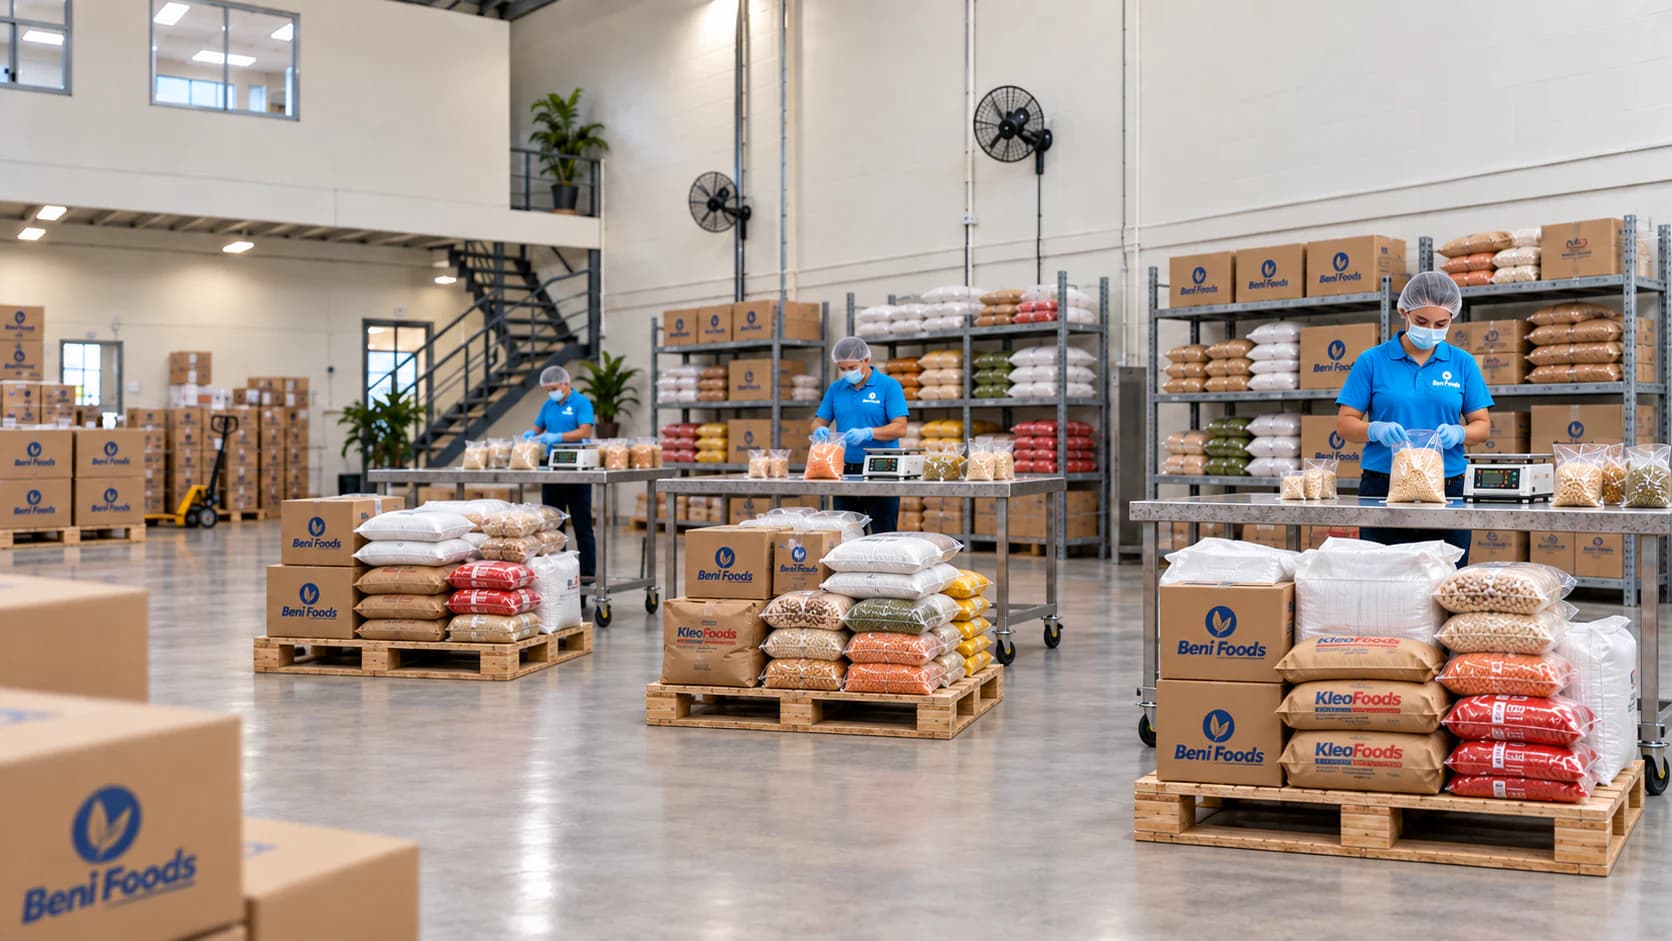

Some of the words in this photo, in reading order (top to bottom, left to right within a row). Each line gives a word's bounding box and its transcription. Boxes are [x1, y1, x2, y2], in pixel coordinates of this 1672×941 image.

[1248, 280, 1265, 290] Beni
[1266, 278, 1288, 288] Foods
[1319, 274, 1337, 284] Beni
[1338, 272, 1361, 282] Foods
[1313, 361, 1333, 373] Beni
[292, 537, 313, 548] Beni
[314, 538, 341, 549] Foods
[697, 569, 721, 581] Beni
[721, 570, 753, 582] Foods
[281, 606, 305, 617] Beni
[306, 607, 337, 618] Foods
[677, 626, 737, 640] KleoFoods
[1177, 640, 1215, 656] Beni
[1216, 641, 1266, 657] Foods
[1315, 690, 1402, 706] KleoFoods
[1174, 744, 1213, 761] Beni
[1213, 745, 1265, 763] Foods
[1315, 742, 1403, 759] KleoFoods
[20, 870, 99, 926] Beni
[102, 847, 197, 902] Foods
